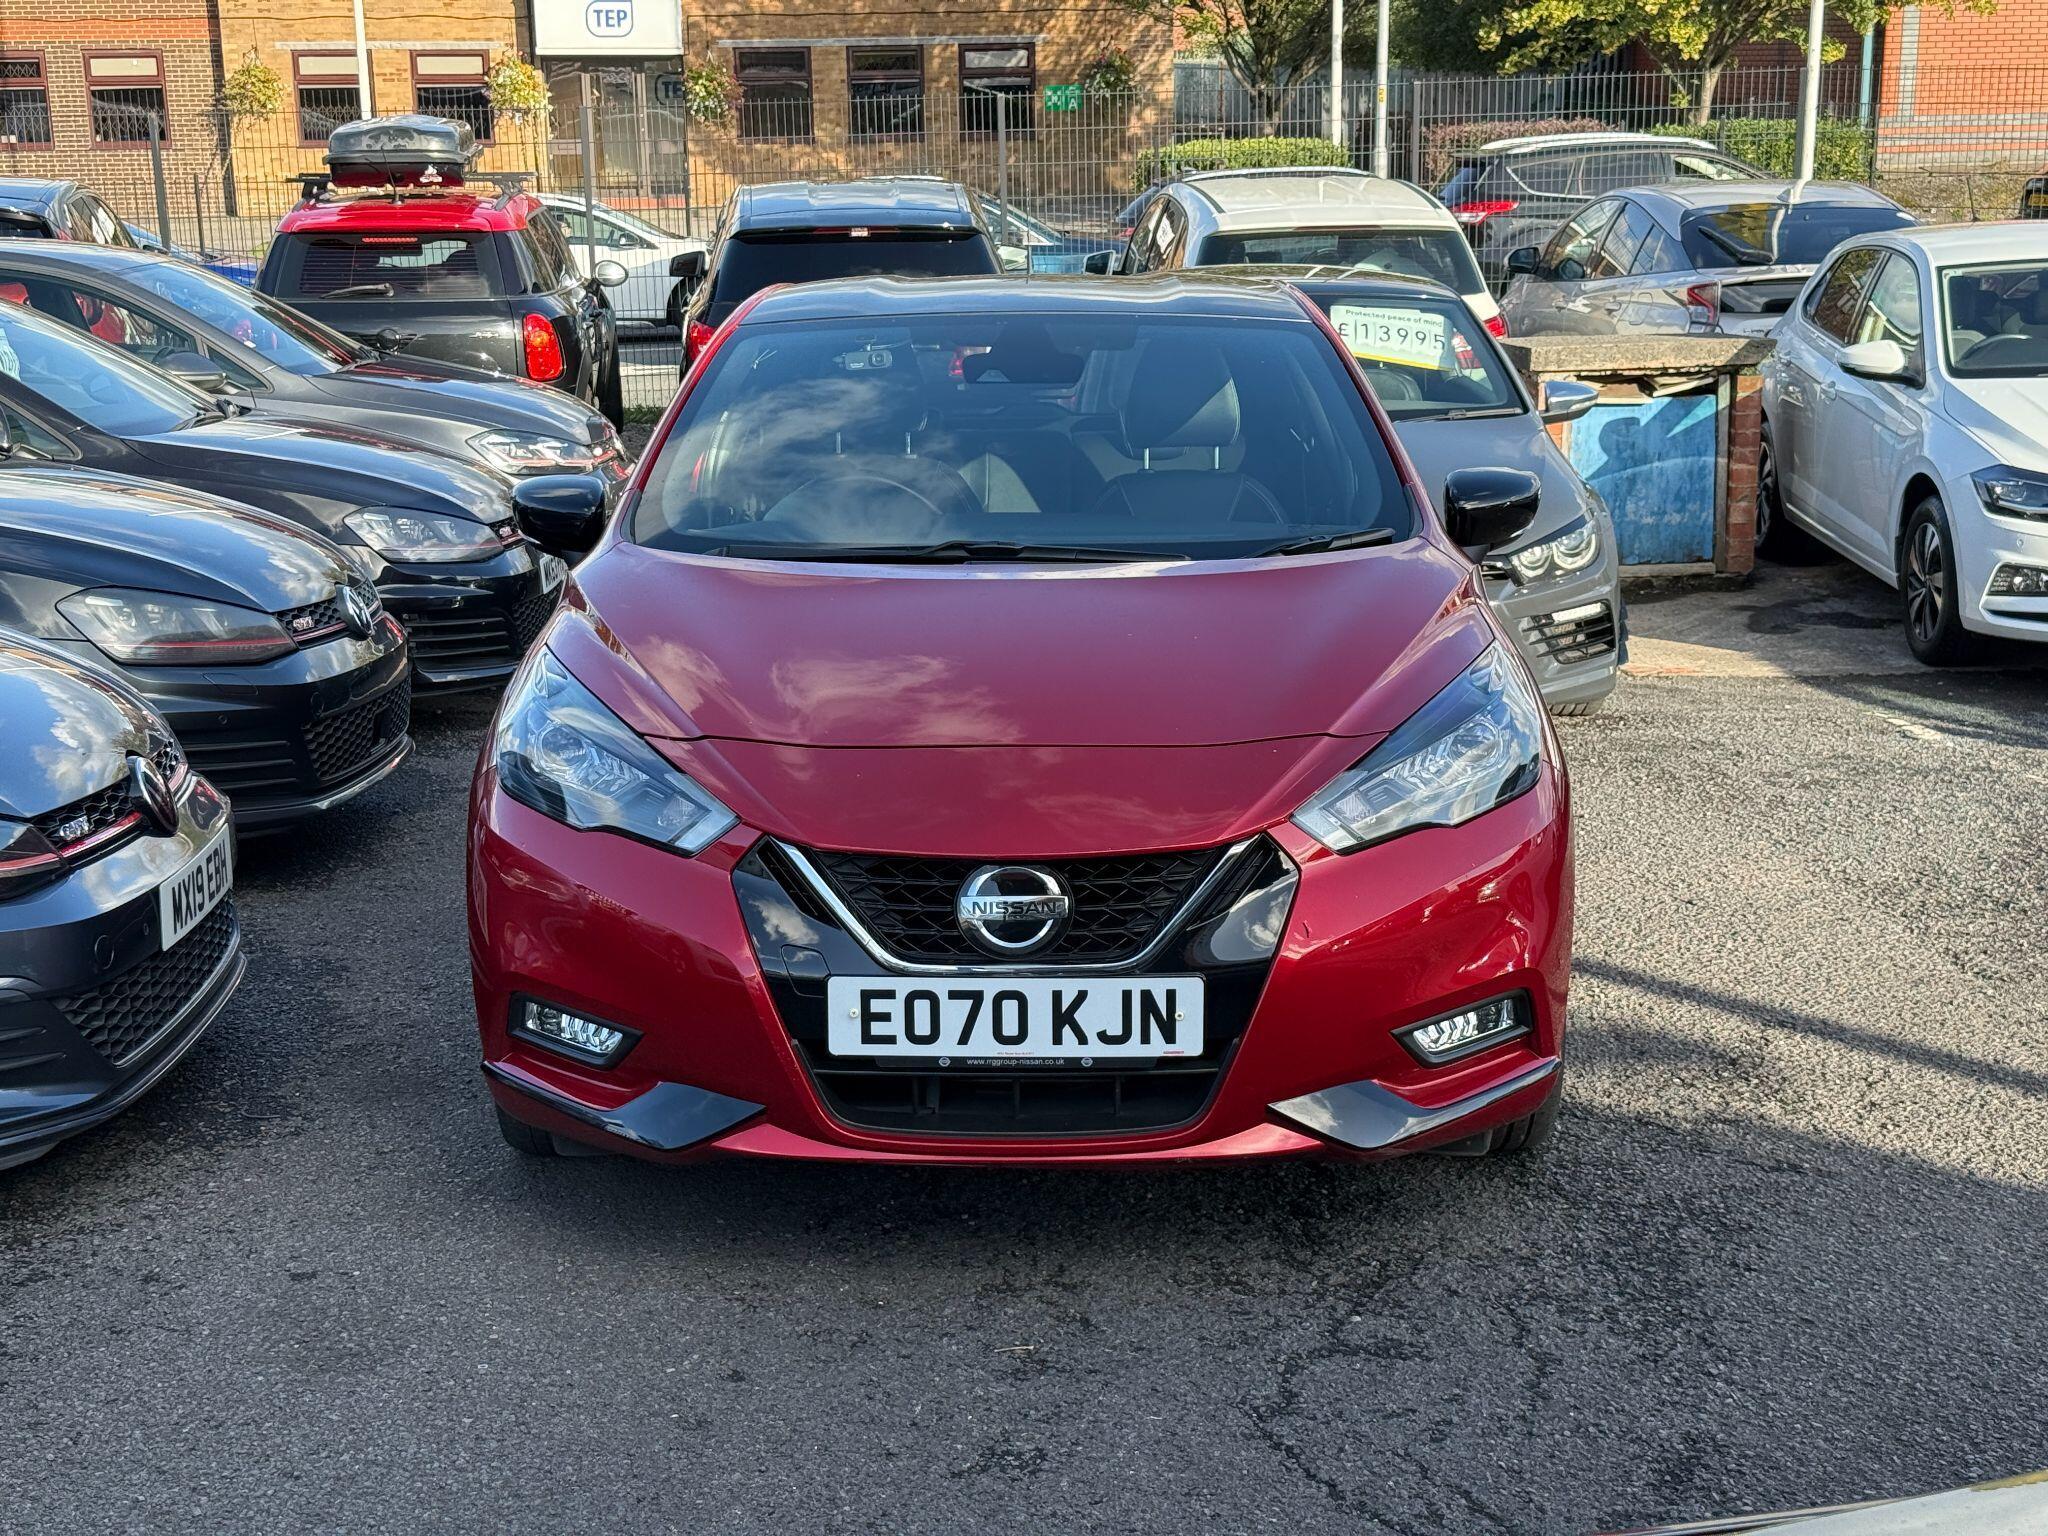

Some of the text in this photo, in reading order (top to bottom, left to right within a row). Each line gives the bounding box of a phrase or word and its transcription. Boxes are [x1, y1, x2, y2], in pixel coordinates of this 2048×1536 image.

[593, 9, 627, 28] TEP
[662, 81, 683, 99] TE
[1345, 309, 1385, 319] Protected
[1387, 314, 1411, 323] peace
[1413, 315, 1422, 324] of
[171, 839, 228, 935] MX19 EBH
[972, 901, 1057, 914] NISSAN
[1052, 989, 1177, 1046] KJN
[966, 1057, 1065, 1068] www.rrggroup-nissan.co.uk
